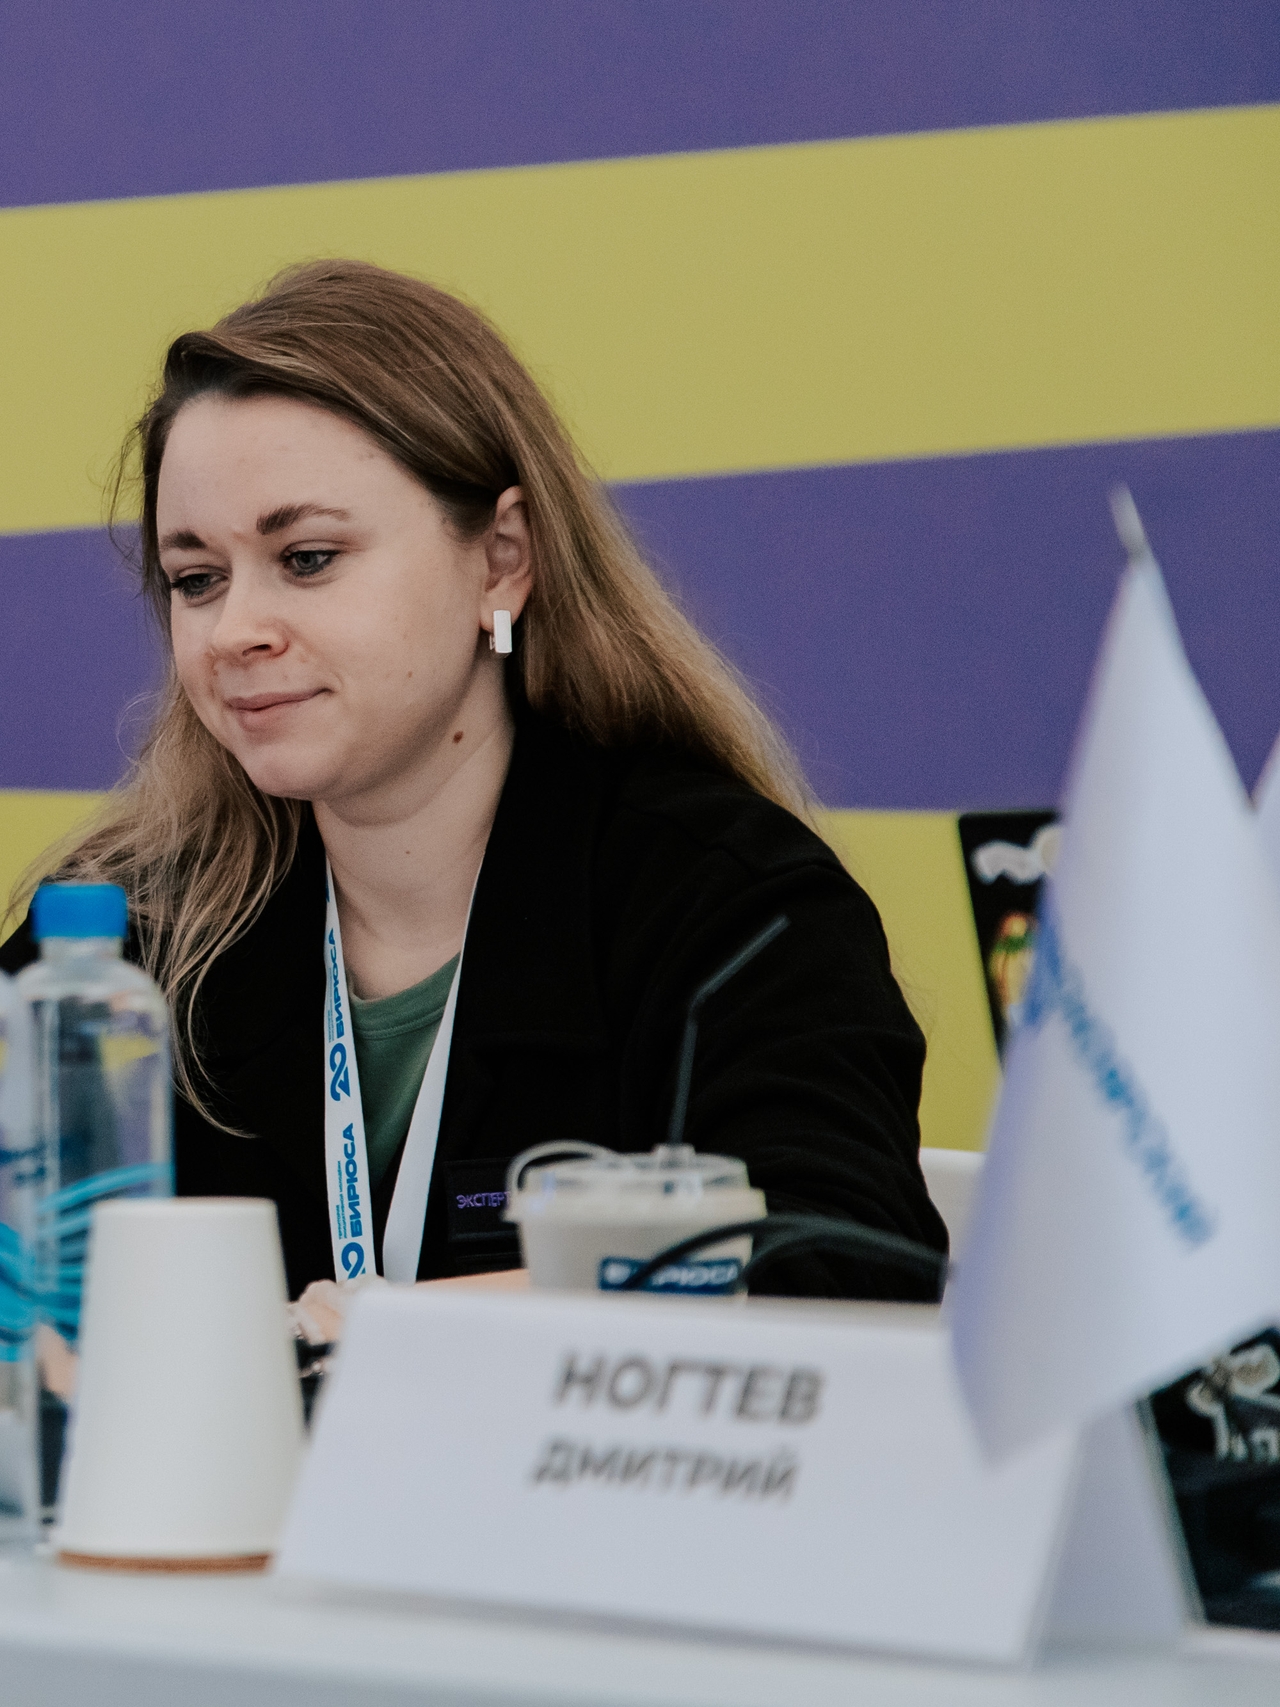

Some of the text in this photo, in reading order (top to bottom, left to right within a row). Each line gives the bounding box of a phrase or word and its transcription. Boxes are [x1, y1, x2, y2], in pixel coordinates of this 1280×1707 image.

[328, 927, 345, 1039] БИРЮСА
[342, 1122, 363, 1238] БИРЮСА
[553, 1351, 826, 1426] НОГТЕВ
[530, 1435, 800, 1505] ДМИТРИЙ
